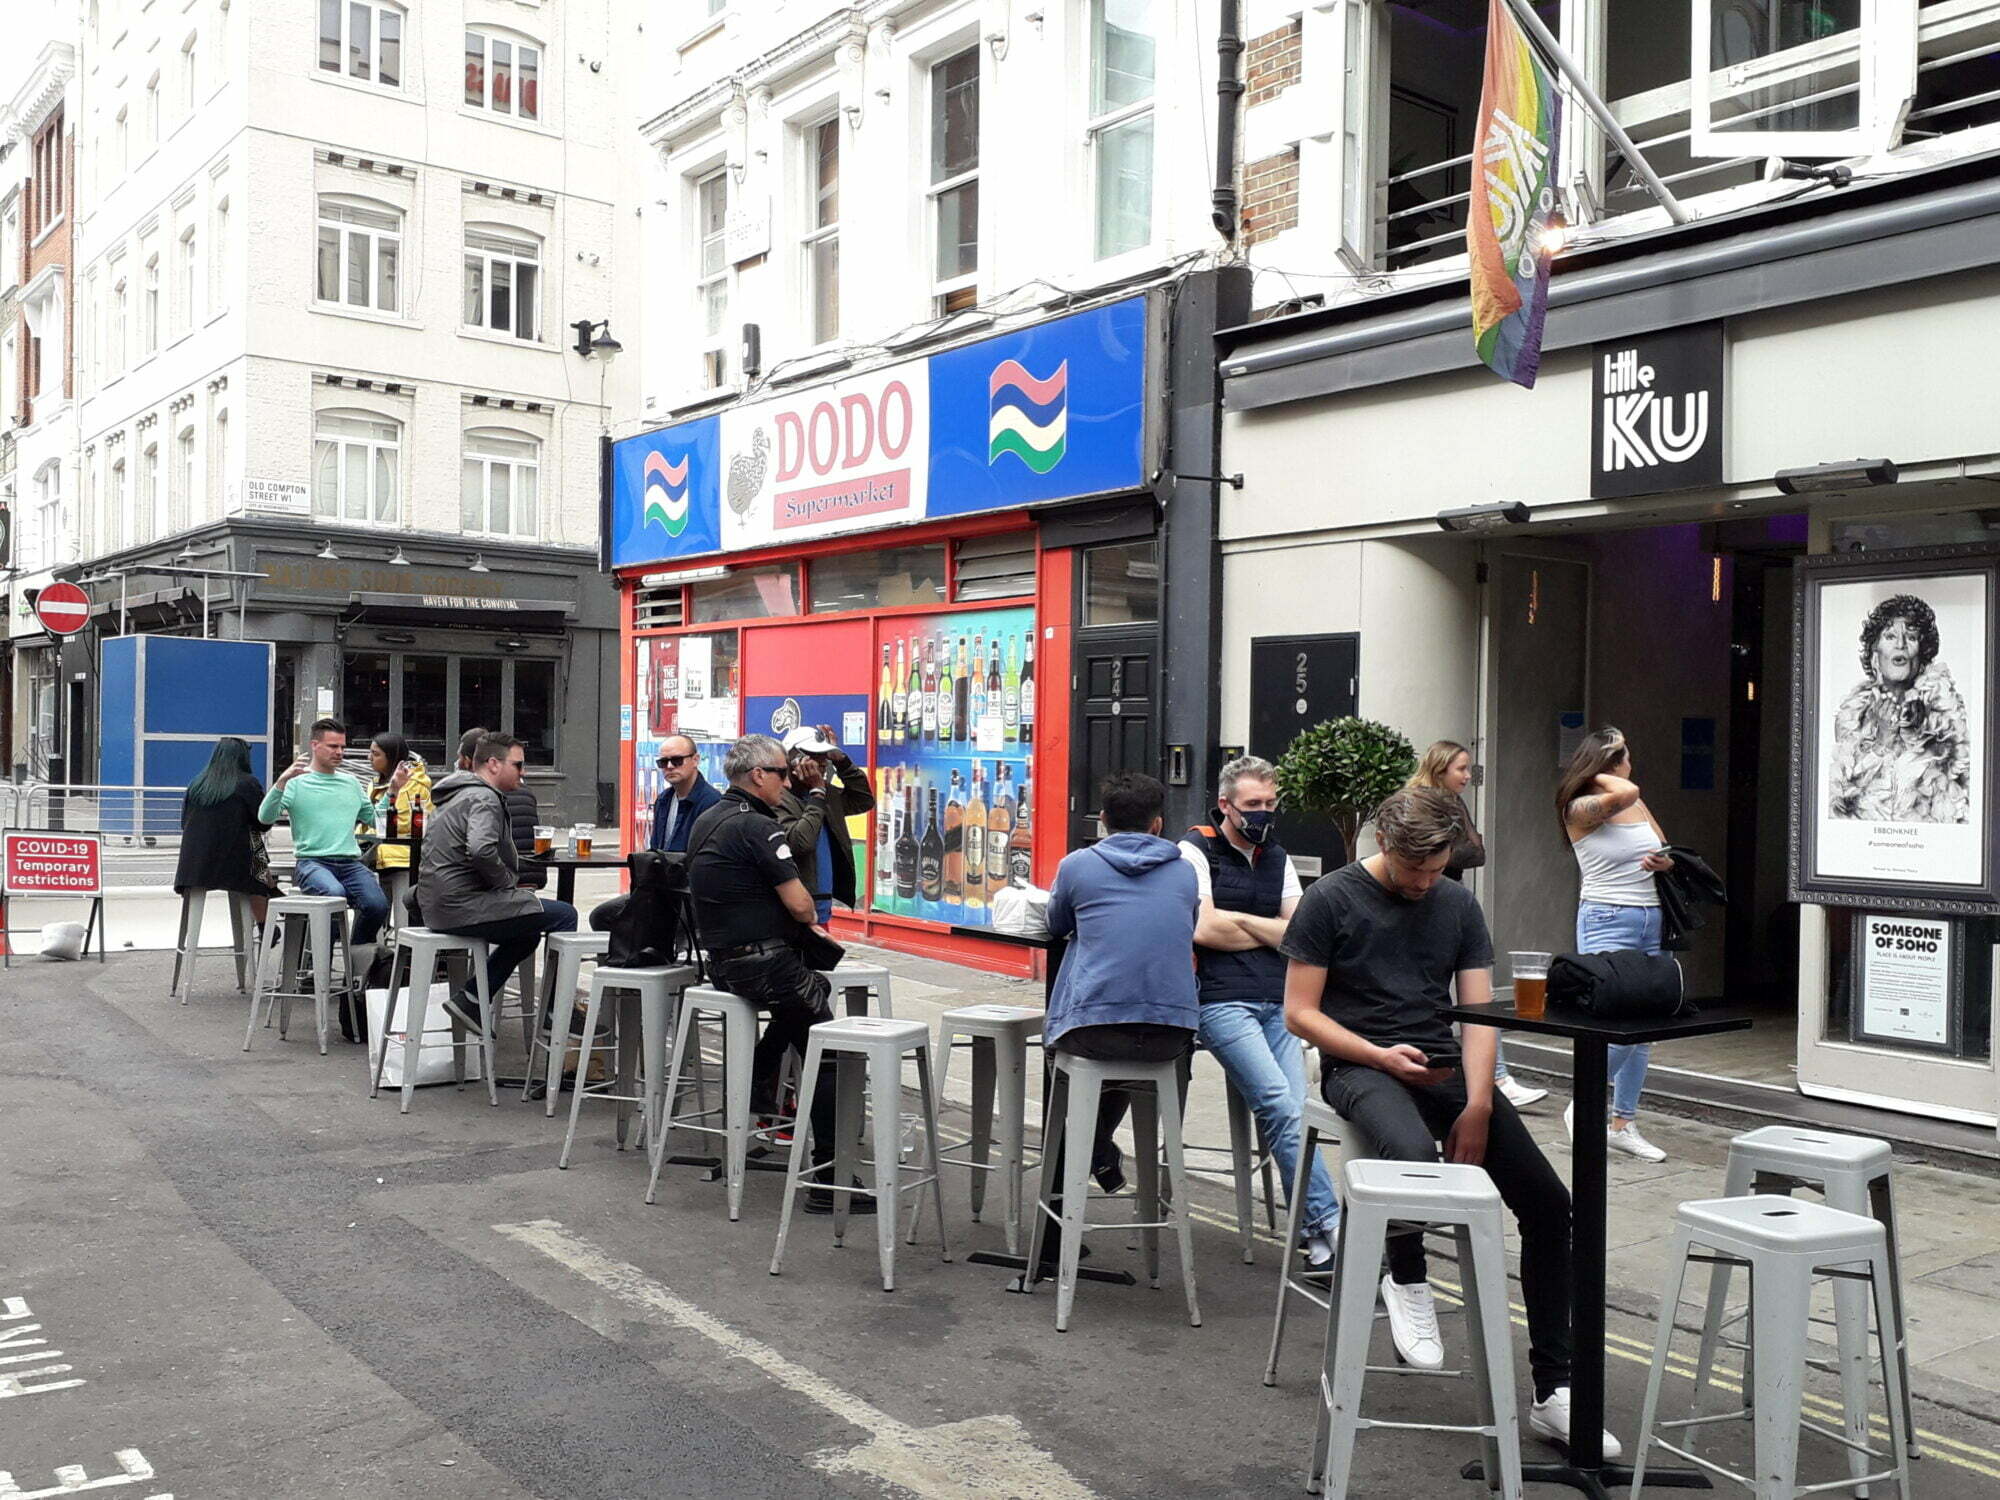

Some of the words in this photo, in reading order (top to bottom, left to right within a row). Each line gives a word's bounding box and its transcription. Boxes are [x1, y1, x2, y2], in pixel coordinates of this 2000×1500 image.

[1604, 349, 1655, 395] little
[775, 380, 912, 483] DODO
[1603, 390, 1709, 472] KU
[249, 481, 264, 490] OLD
[268, 483, 306, 494] COMPTON
[249, 491, 278, 501] STREET
[281, 494, 292, 502] W1
[785, 481, 895, 518] Supermarket
[422, 595, 448, 606] HAVEN
[449, 597, 464, 608] FOR
[465, 598, 480, 608] THE
[663, 667, 675, 678] THE
[1112, 661, 1120, 696] 24
[1296, 652, 1307, 693] 25
[663, 678, 678, 689] BEST
[17, 840, 88, 854] COVID-19
[16, 859, 90, 874] Temporary
[12, 874, 94, 886] restrictions
[1871, 922, 1942, 940] SOMEONE
[1875, 936, 1893, 949] OF
[1896, 938, 1938, 953] SOHO
